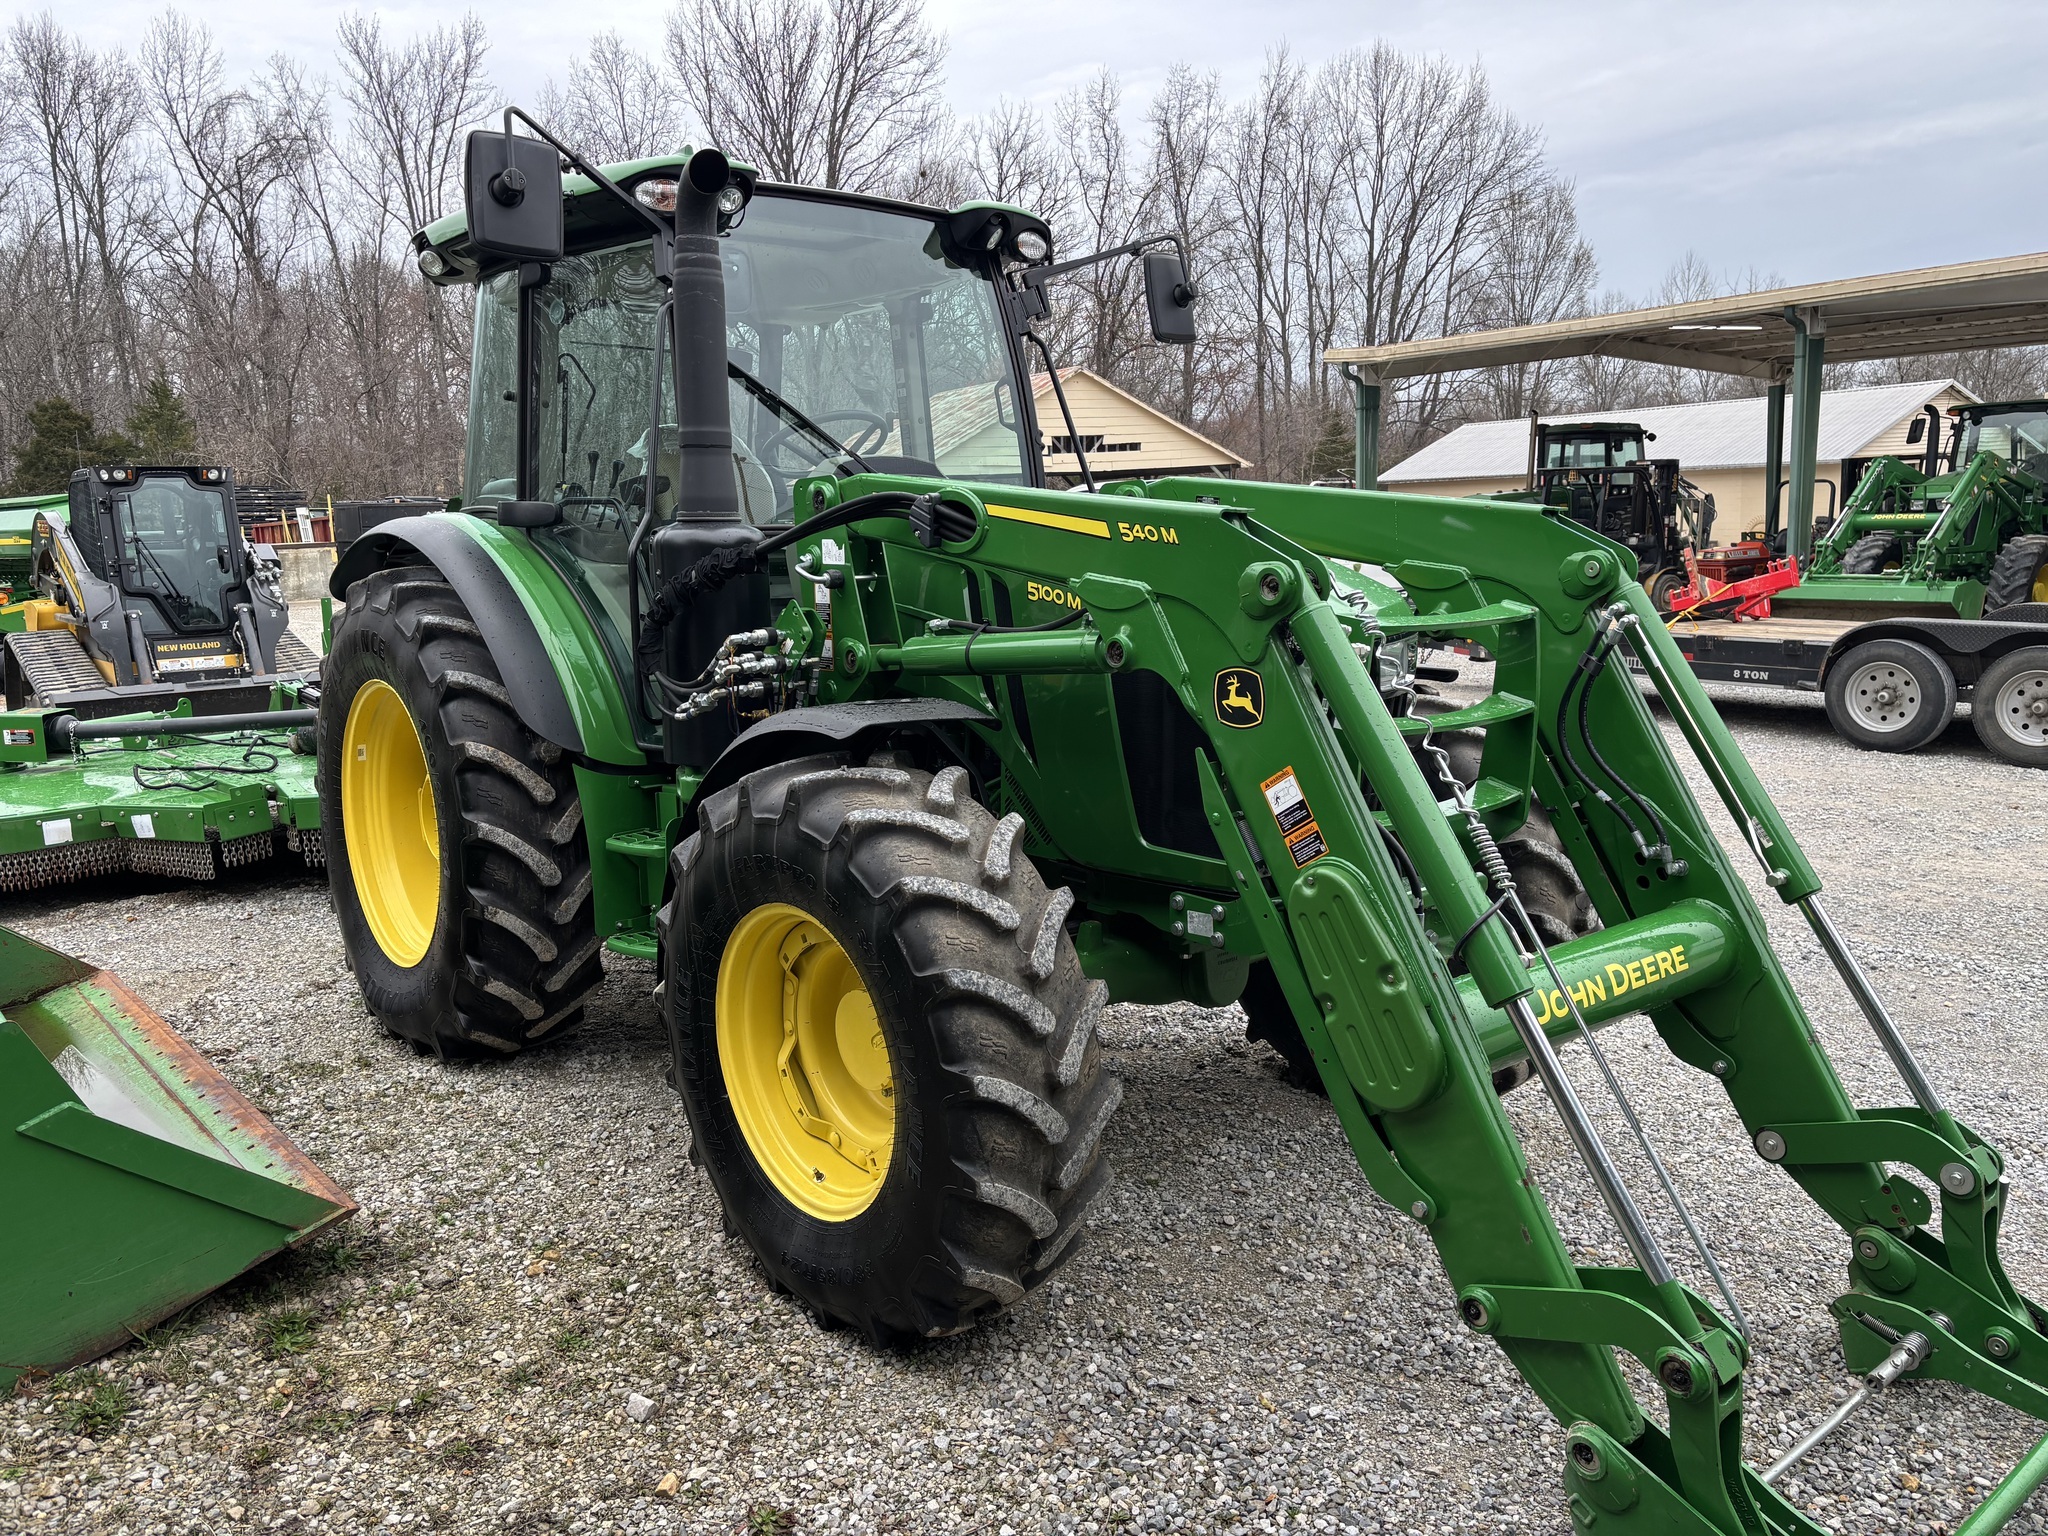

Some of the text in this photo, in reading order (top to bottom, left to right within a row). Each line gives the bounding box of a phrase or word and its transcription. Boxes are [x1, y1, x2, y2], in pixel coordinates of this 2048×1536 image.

[1117, 521, 1180, 545] 540 M
[1027, 581, 1083, 611] 5100 M
[157, 641, 221, 653] NEW HOLLAND
[1733, 669, 1769, 681] 8 TON
[1269, 769, 1290, 786] WARNING
[1294, 825, 1315, 840] WARNING
[1537, 944, 1690, 1026] JOHN DEERE
